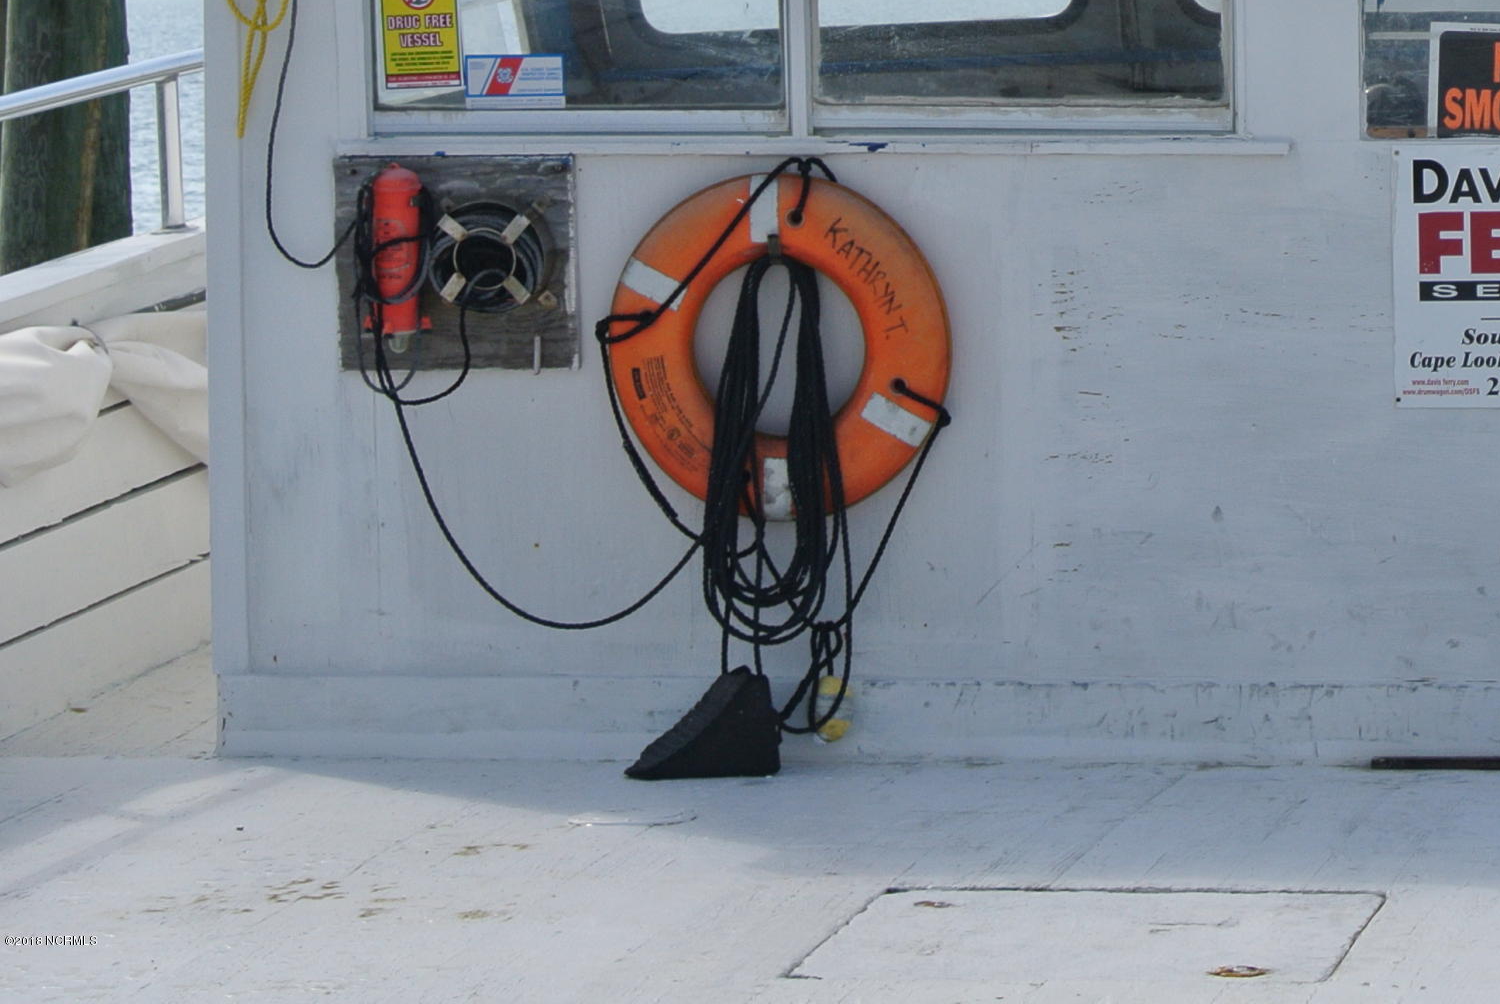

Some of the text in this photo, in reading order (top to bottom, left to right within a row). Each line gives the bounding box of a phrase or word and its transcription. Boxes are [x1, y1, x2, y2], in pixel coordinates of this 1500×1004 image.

[387, 13, 453, 31] DRUG FREE
[399, 32, 443, 48] VESSEL
[824, 217, 903, 315] KATHRYN
[1410, 351, 1456, 372] Cape
